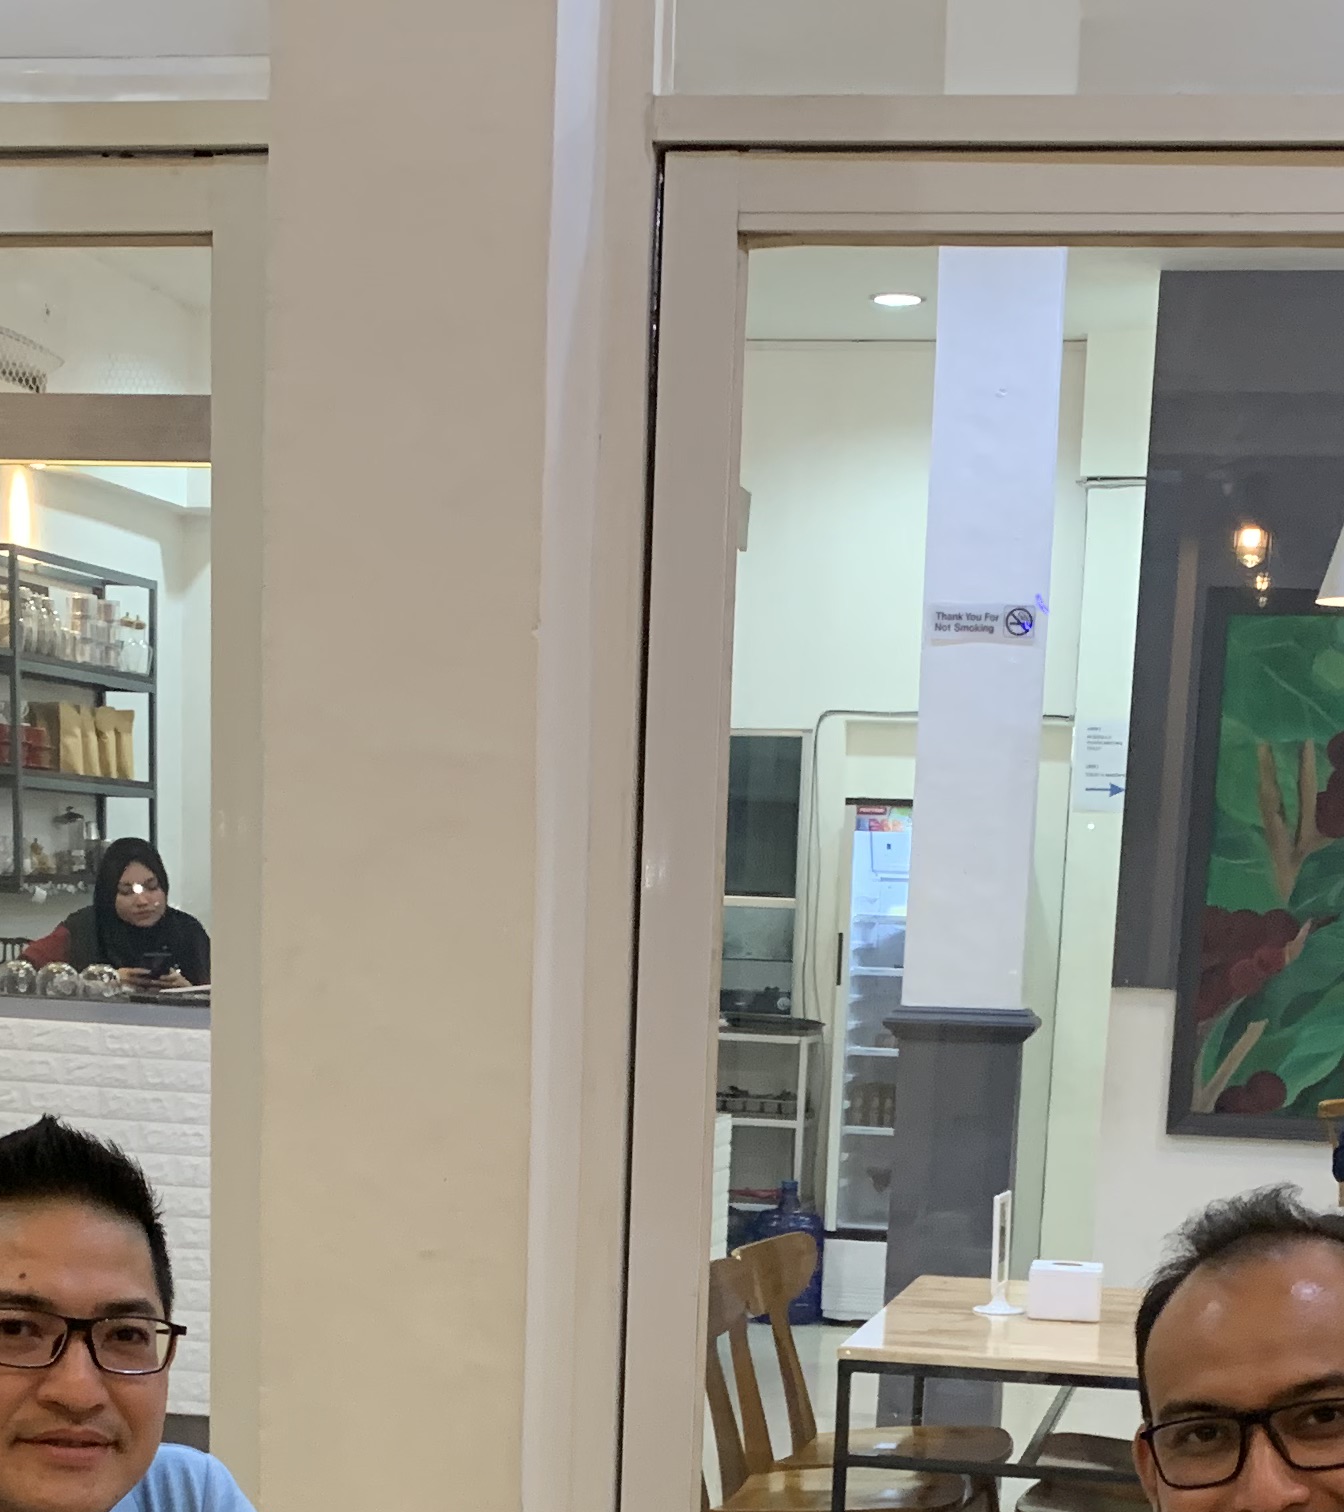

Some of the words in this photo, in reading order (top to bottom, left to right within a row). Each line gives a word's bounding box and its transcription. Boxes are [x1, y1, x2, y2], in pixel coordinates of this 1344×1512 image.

[935, 611, 963, 621] Thank
[965, 612, 982, 621] You
[984, 612, 999, 621] For
[934, 622, 951, 632] Not
[953, 623, 995, 635] Smoking
